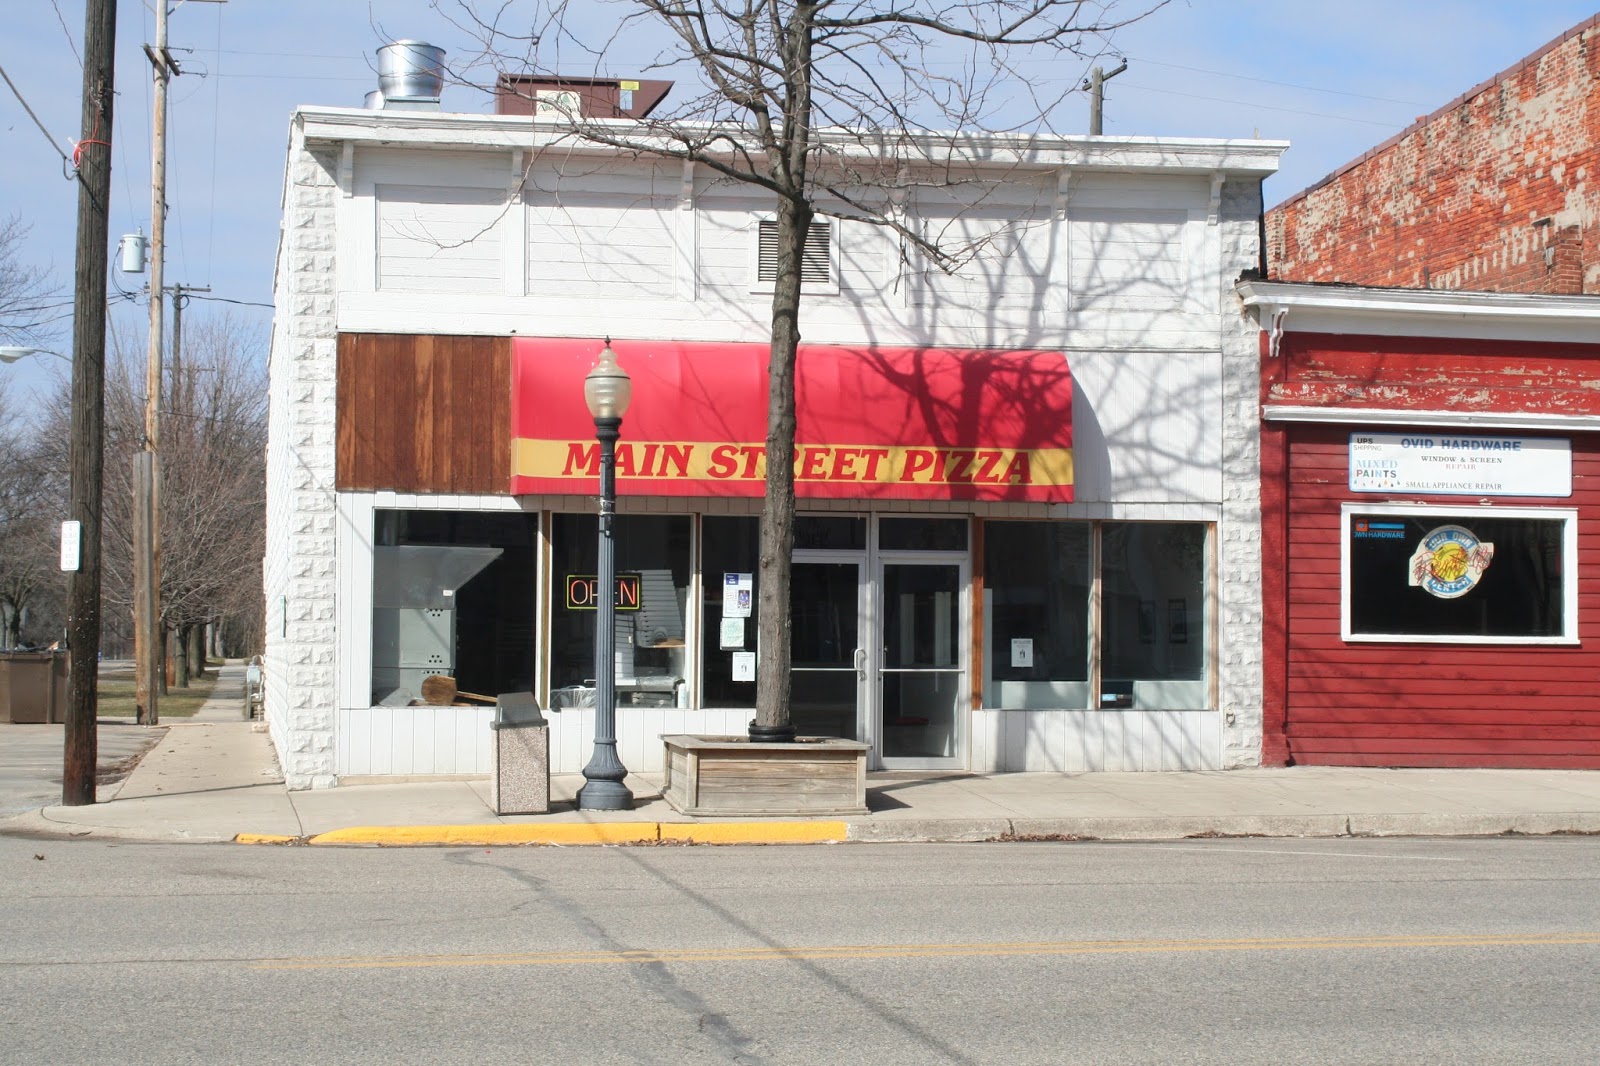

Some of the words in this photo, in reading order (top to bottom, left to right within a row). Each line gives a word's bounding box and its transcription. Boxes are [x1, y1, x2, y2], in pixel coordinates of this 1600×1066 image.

[1401, 438, 1434, 449] OVID
[1441, 439, 1522, 452] HARDWARE
[561, 443, 694, 477] MAIN
[706, 445, 890, 481] STEET
[899, 449, 1033, 484] PIZZA
[1421, 455, 1457, 463] WINDOW
[1356, 460, 1398, 469] MIXED
[1356, 469, 1397, 478] PAINTS
[1432, 481, 1472, 490] APPLIANCE
[1475, 482, 1502, 490] REPAIR
[1369, 531, 1405, 539] HARDWARE
[1452, 532, 1474, 549] OWN
[570, 579, 636, 605] OPN
